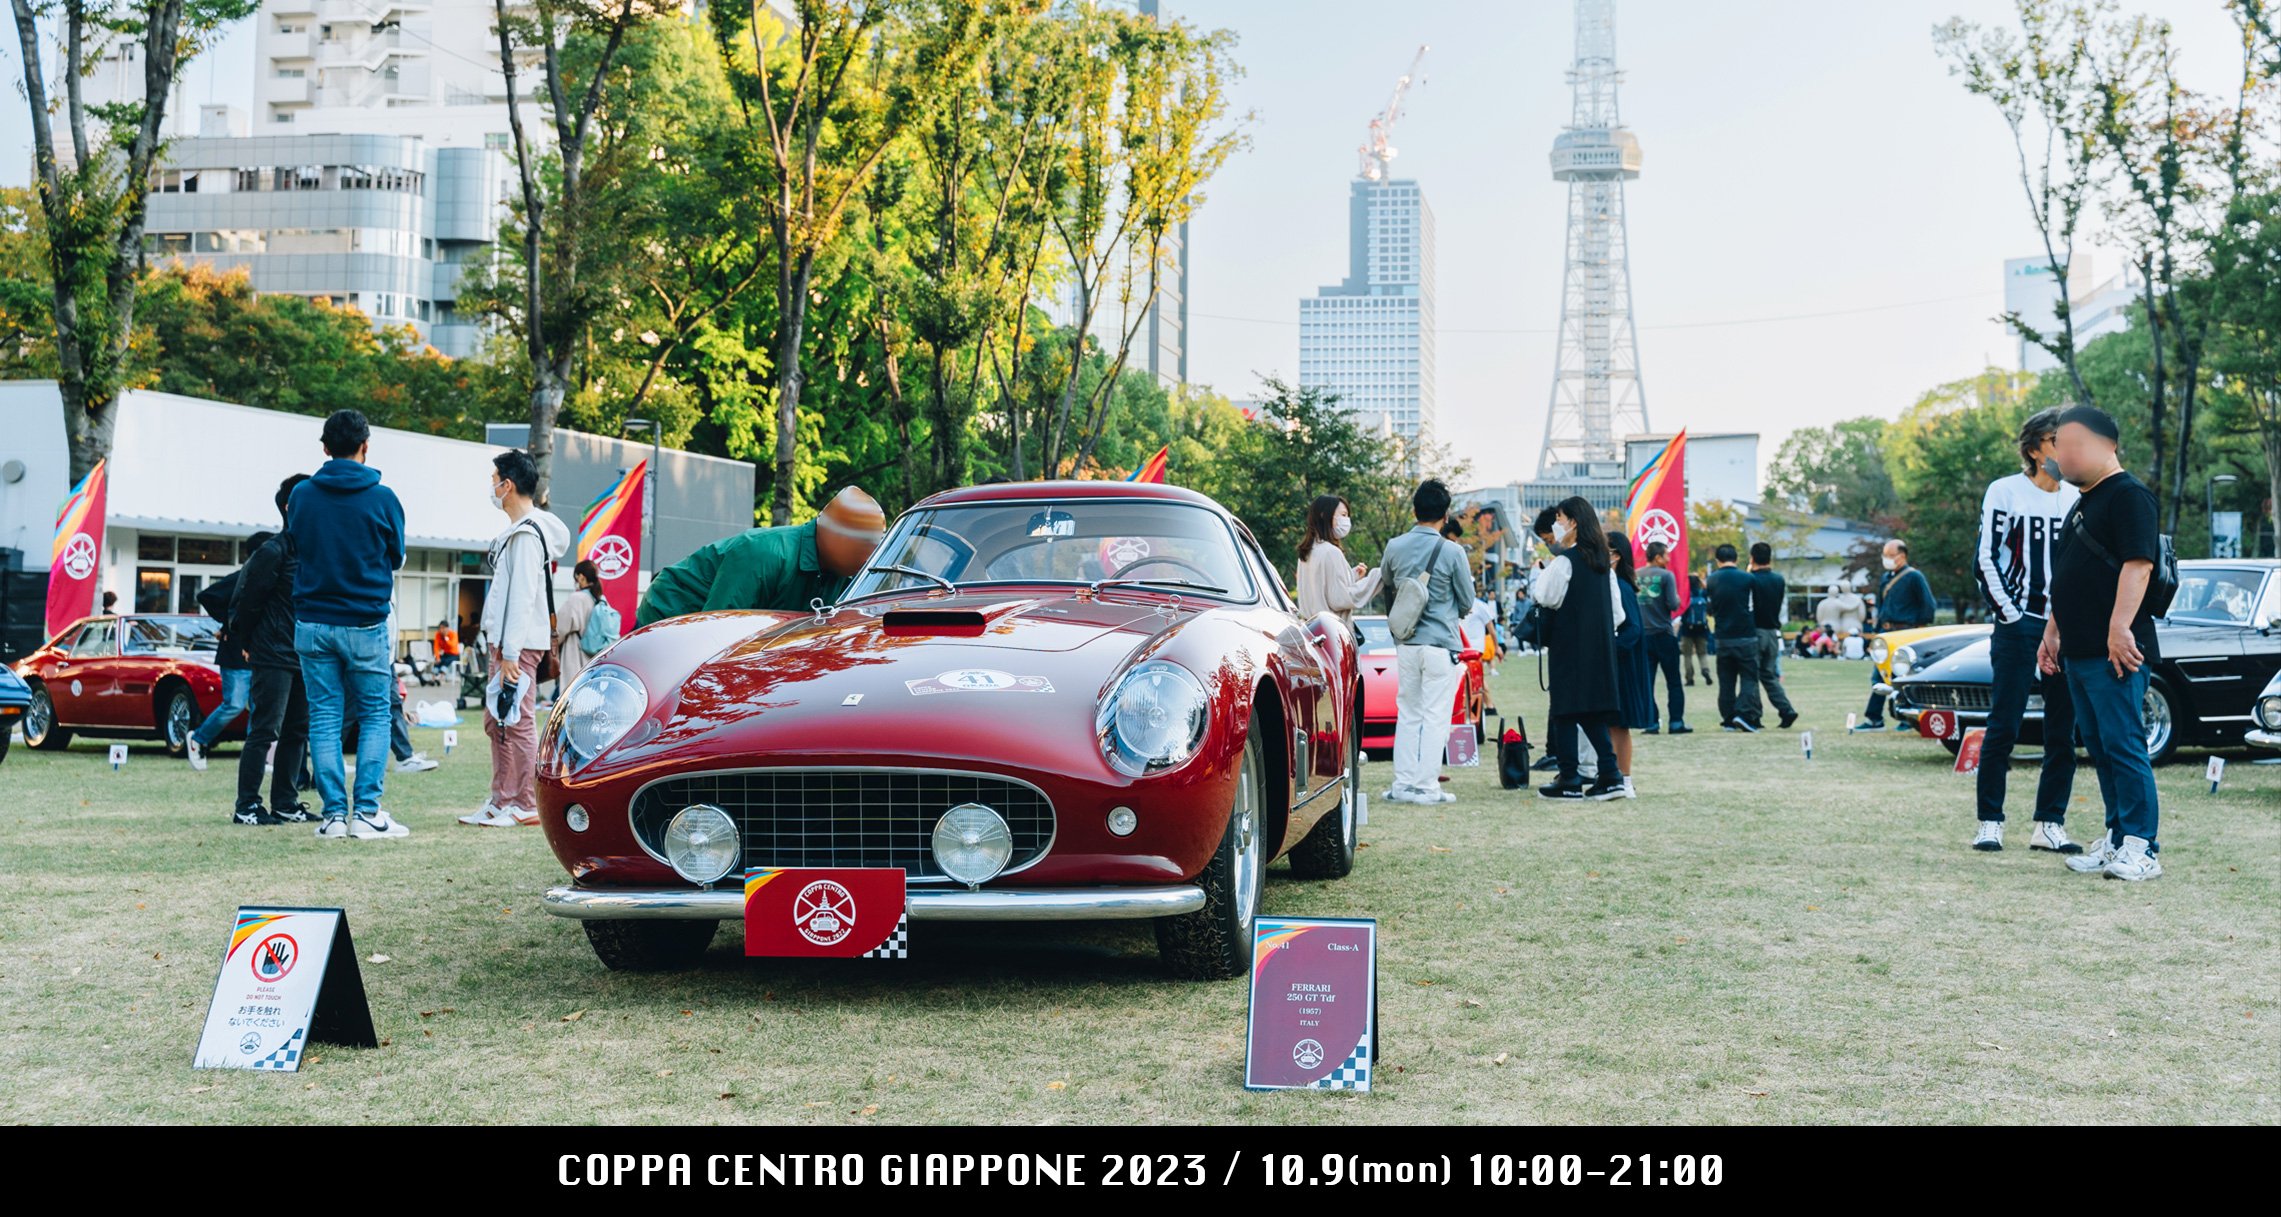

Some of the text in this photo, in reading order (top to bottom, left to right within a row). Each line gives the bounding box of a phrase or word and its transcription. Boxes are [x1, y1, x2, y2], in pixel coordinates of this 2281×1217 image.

[957, 675, 995, 684] 41
[804, 884, 845, 897] COPPA CENTRO
[804, 928, 831, 942] GIAPPONE
[1265, 941, 1359, 951] No.41 Class-A
[1291, 983, 1331, 992] FERRARI
[1286, 993, 1336, 1002] 250 GT Tdf
[238, 1006, 281, 1015] お手を触れ
[228, 1018, 285, 1027] ないでください
